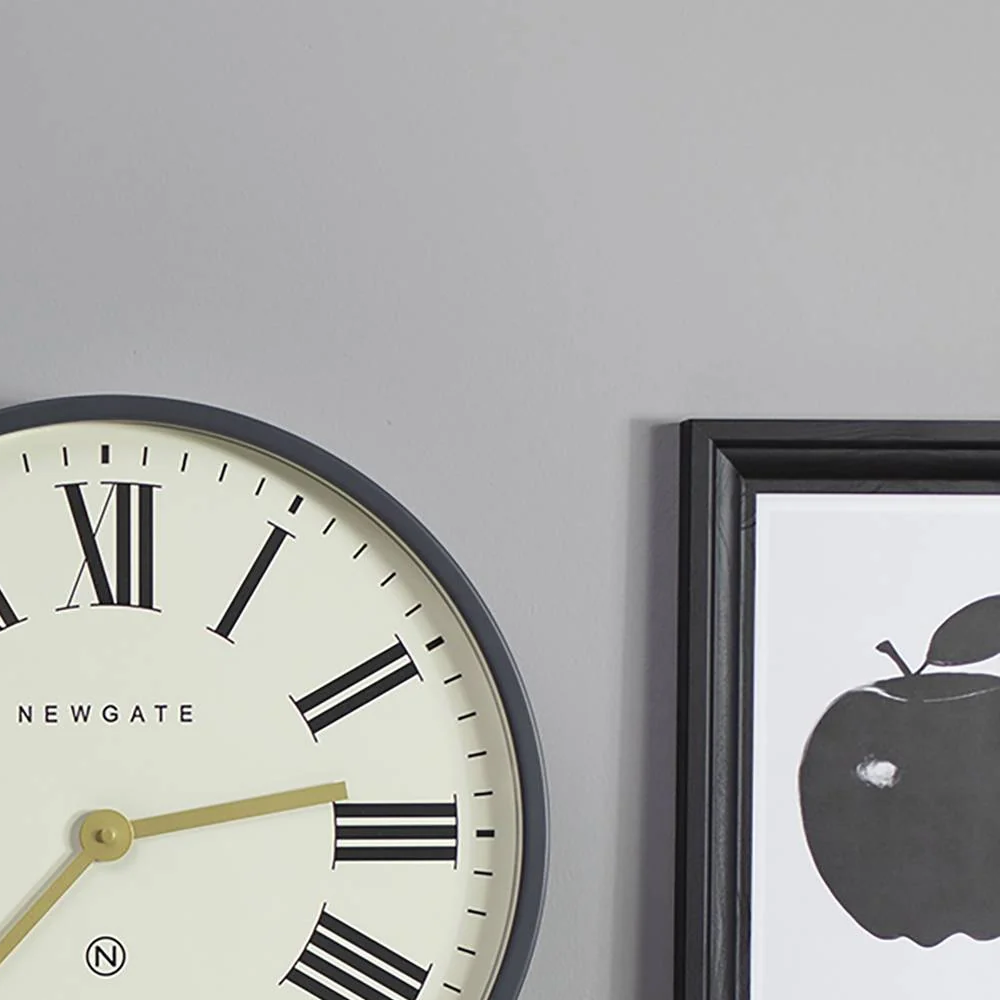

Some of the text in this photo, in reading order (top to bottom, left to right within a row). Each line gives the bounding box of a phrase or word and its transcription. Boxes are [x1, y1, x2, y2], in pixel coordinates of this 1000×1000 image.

[54, 481, 162, 613] XII
[206, 521, 296, 644] I
[17, 703, 194, 724] NEWGATE
[289, 634, 423, 742] II
[332, 794, 457, 870] III
